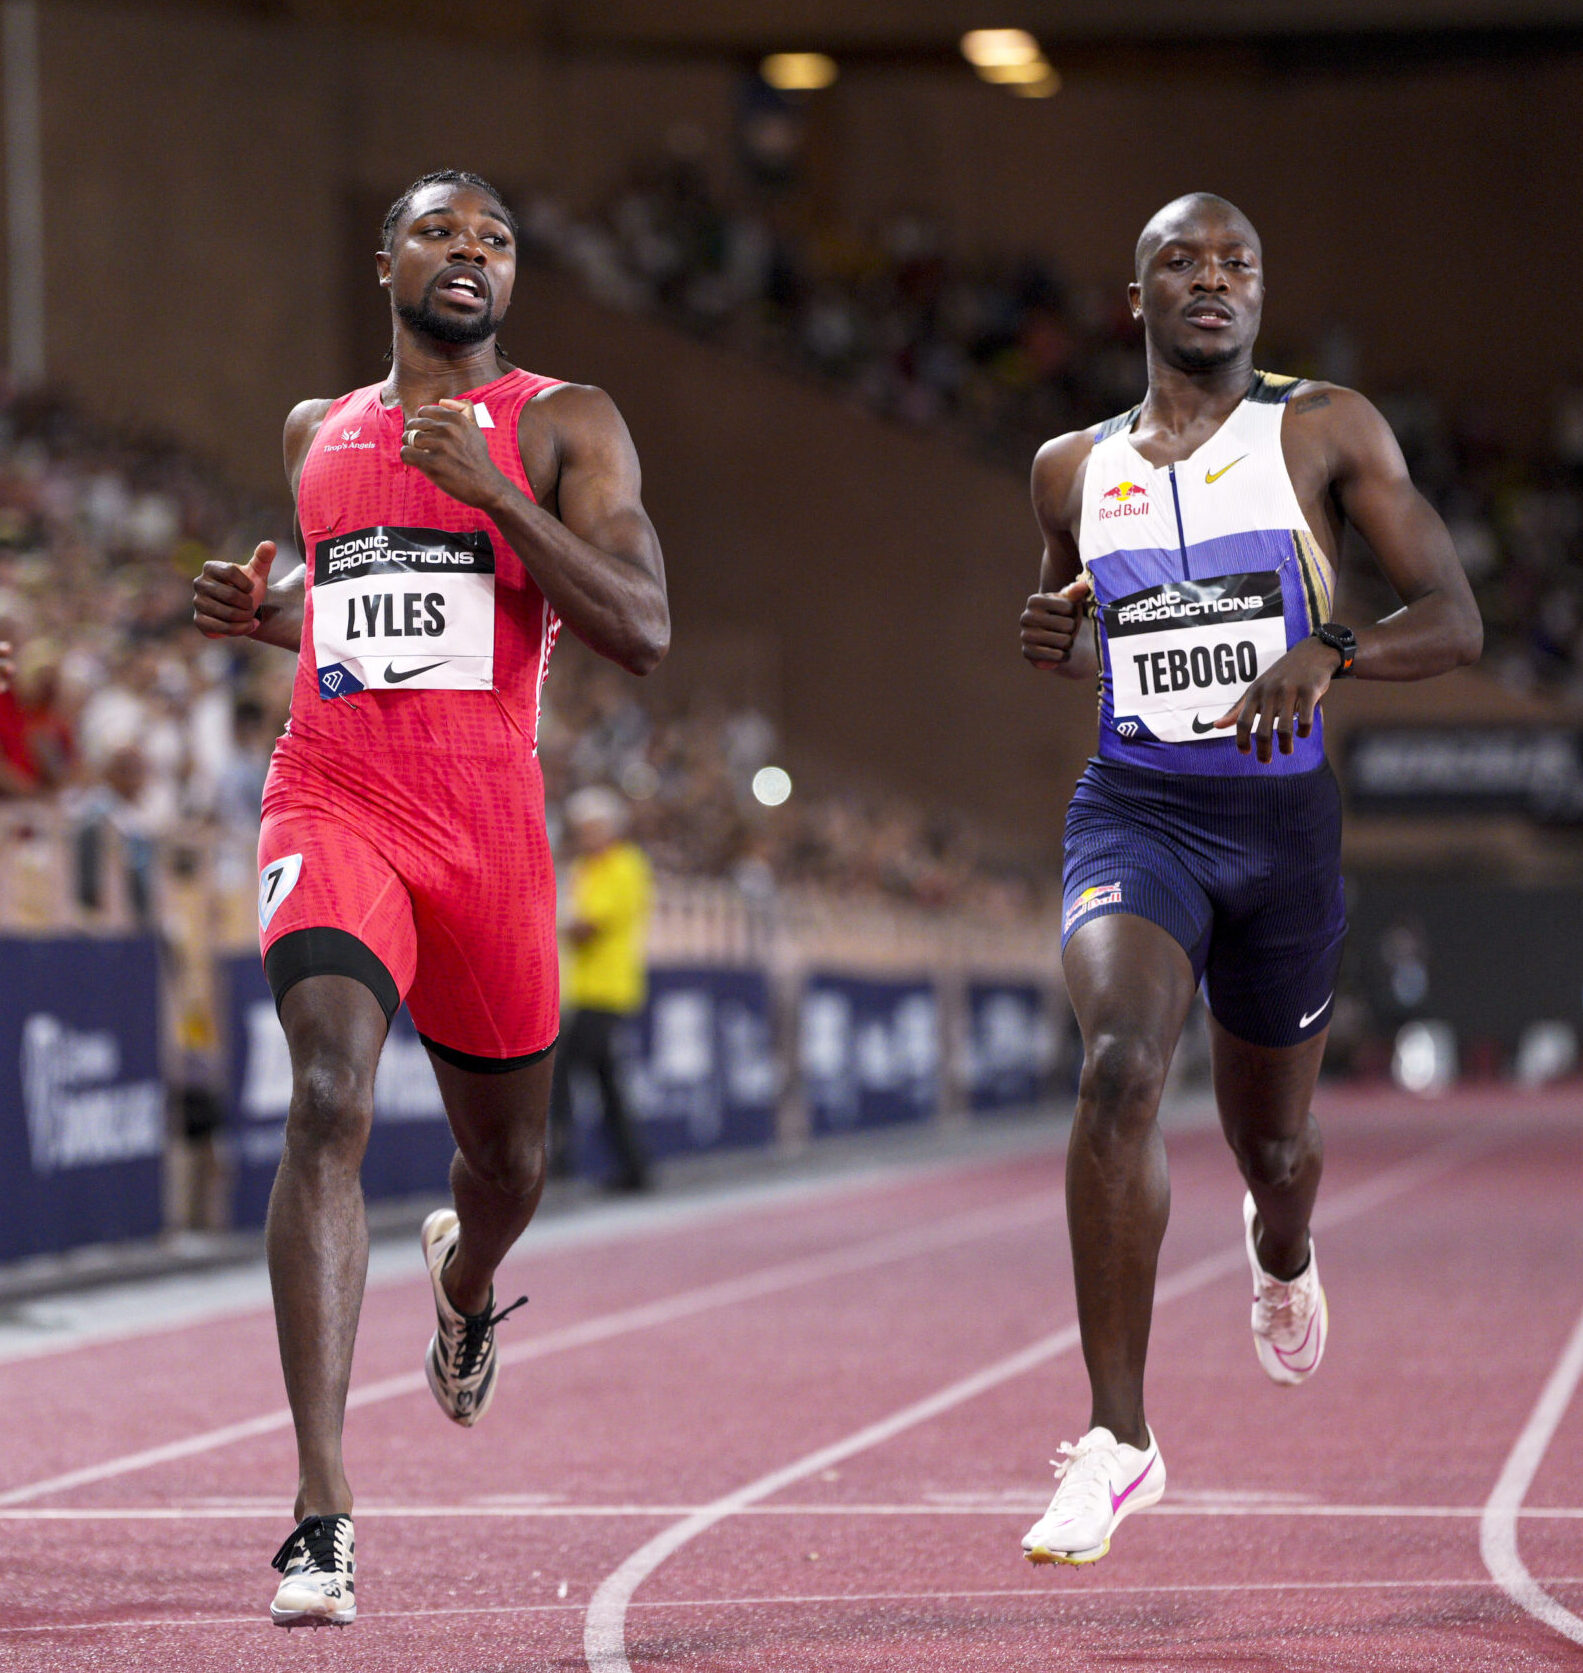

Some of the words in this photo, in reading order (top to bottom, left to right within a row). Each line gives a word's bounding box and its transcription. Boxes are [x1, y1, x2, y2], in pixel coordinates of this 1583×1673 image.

[323, 442, 348, 453] Tirop's
[348, 441, 375, 449] Angels
[1099, 504, 1122, 521] Red
[1124, 502, 1149, 516] Bull
[329, 536, 389, 560] ICONIC
[328, 551, 475, 574] PRODUCTIONS
[346, 592, 446, 641] LYLES
[1117, 596, 1264, 625] PRODUCTIONS
[1133, 640, 1258, 696] TEBOGO
[267, 866, 284, 904] 7
